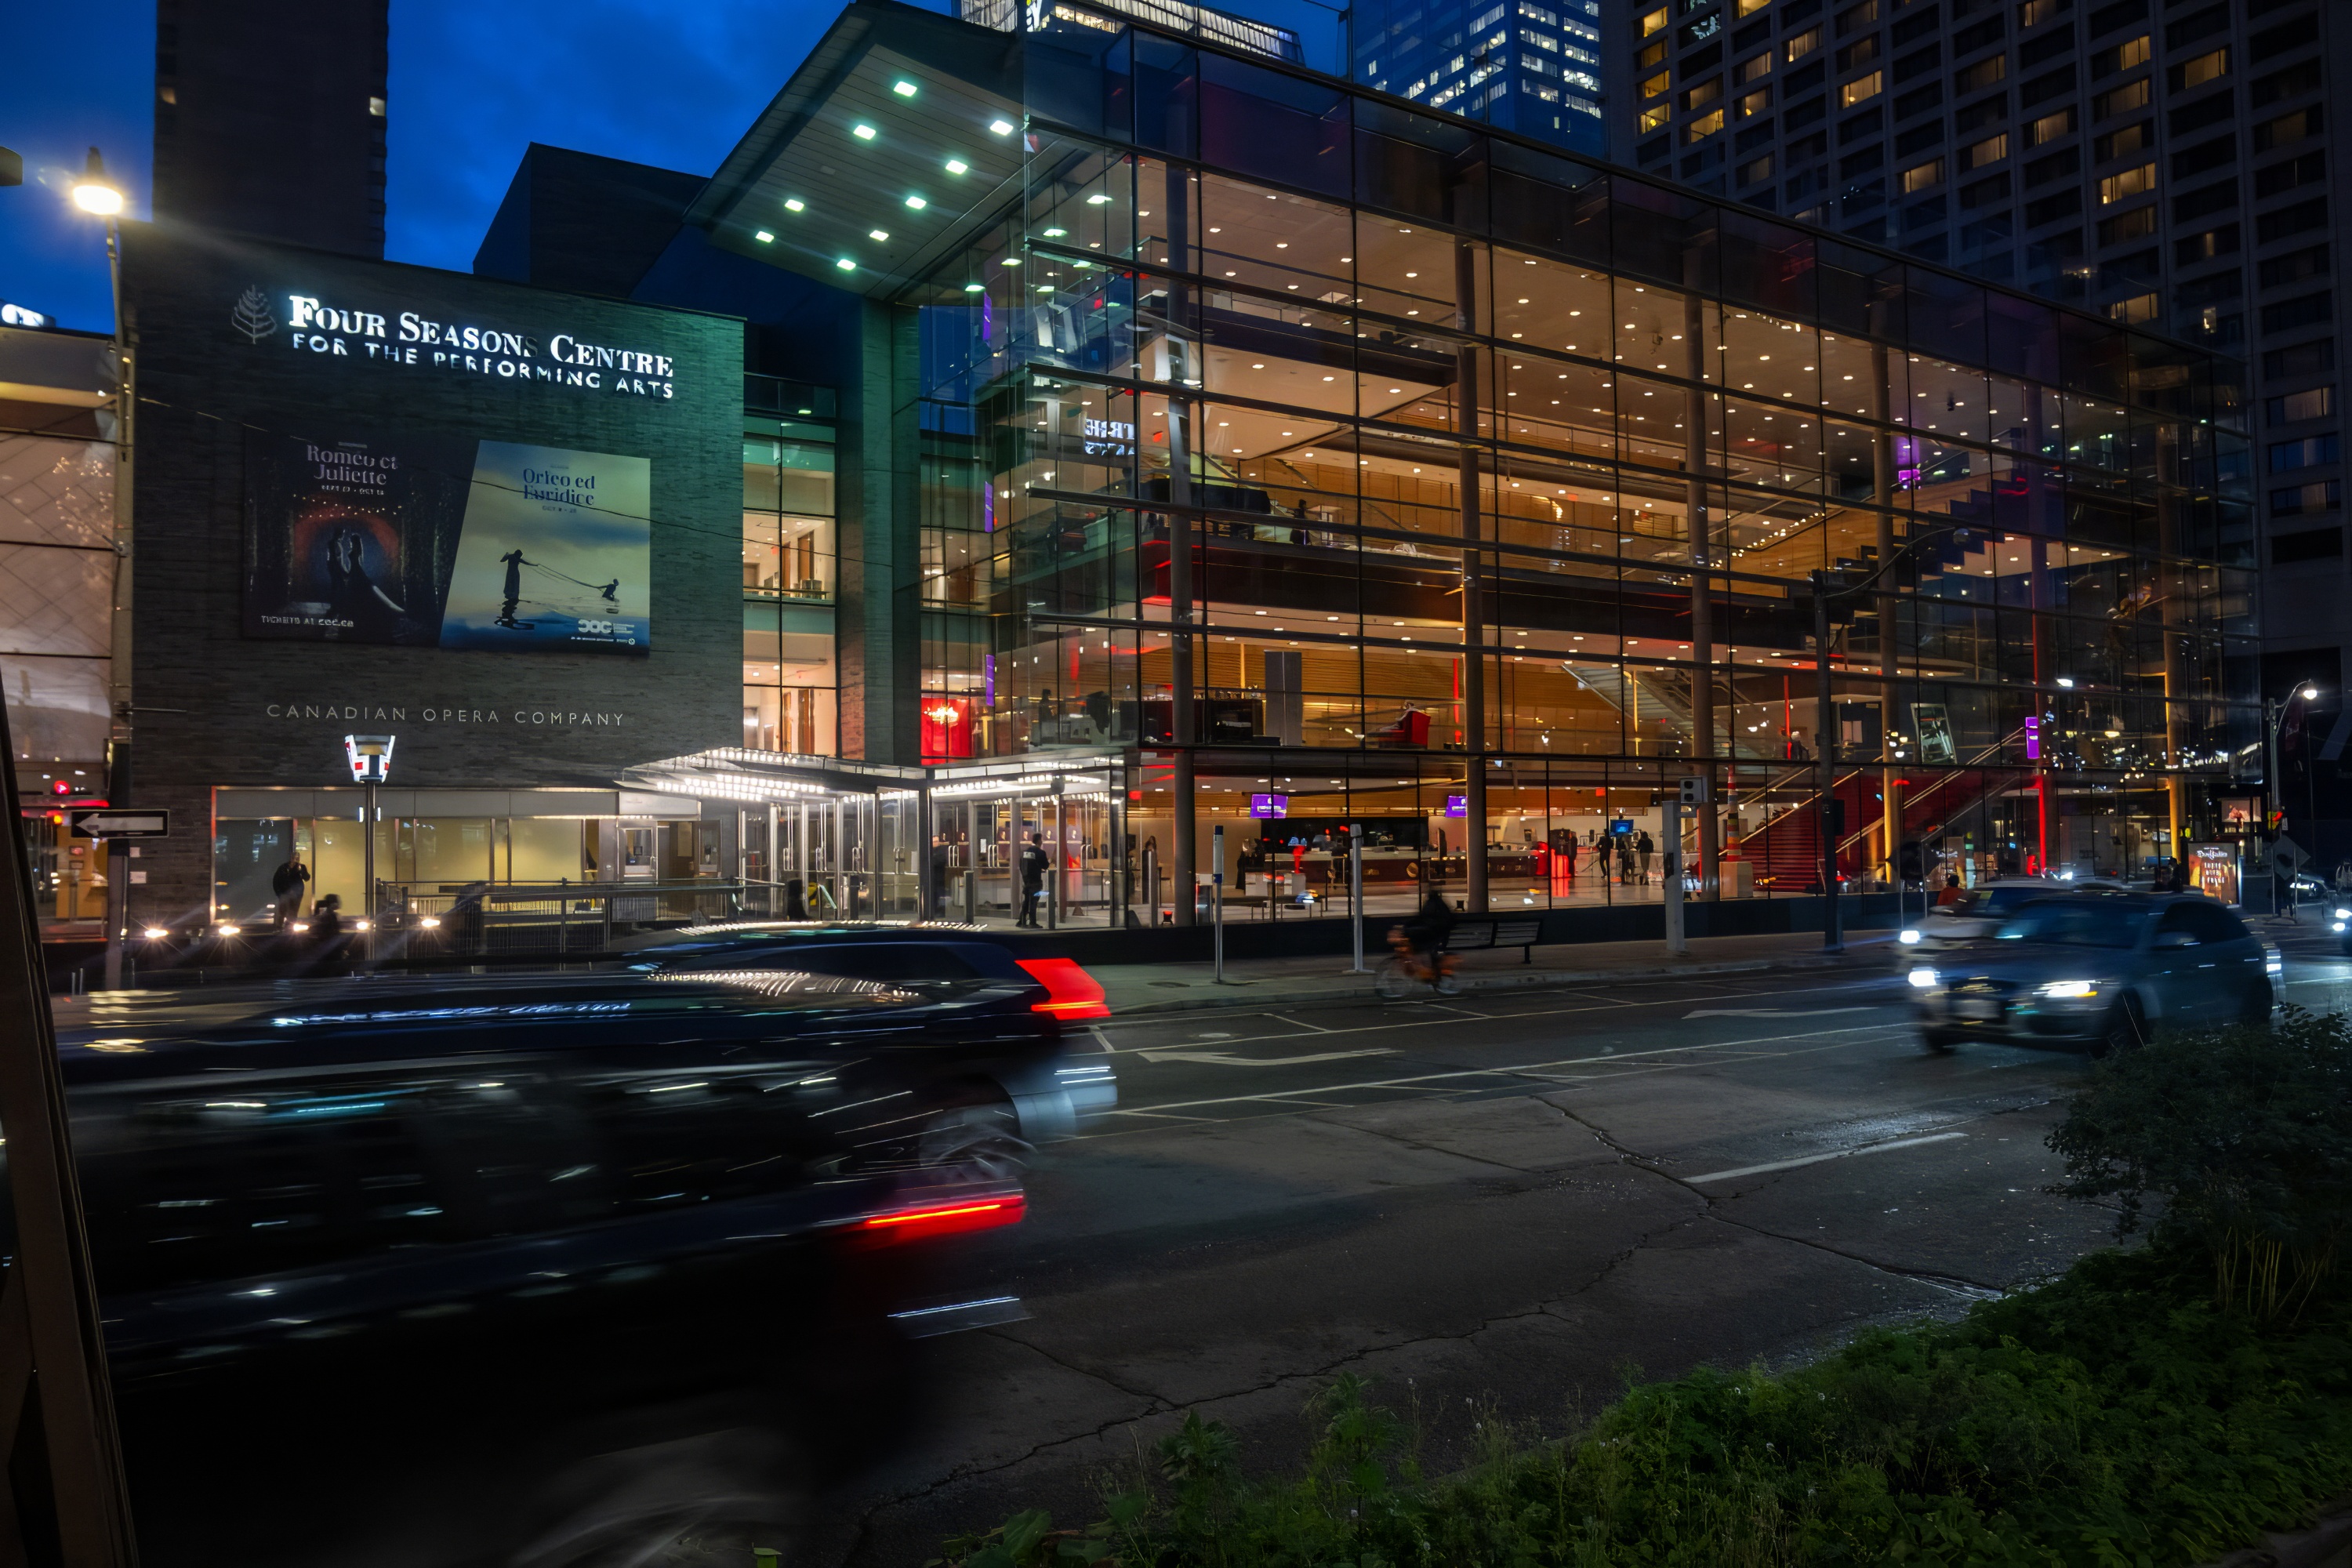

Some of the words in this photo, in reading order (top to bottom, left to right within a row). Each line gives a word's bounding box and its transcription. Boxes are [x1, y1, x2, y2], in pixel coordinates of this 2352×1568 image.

[289, 295, 386, 338] FOUR
[399, 311, 538, 357] SEASONS
[550, 334, 673, 378] CENTRE
[293, 333, 348, 356] FOR
[364, 342, 418, 365] THE
[434, 351, 601, 388] PERFORMING
[615, 377, 673, 399] ARTS
[314, 463, 387, 485] Juliette
[523, 468, 571, 487] Orfeo
[575, 475, 595, 489] ed
[524, 485, 594, 506] Euridice
[267, 704, 405, 720] CANADIAN
[423, 708, 499, 723] OPERA
[514, 711, 622, 726] COMPANY
